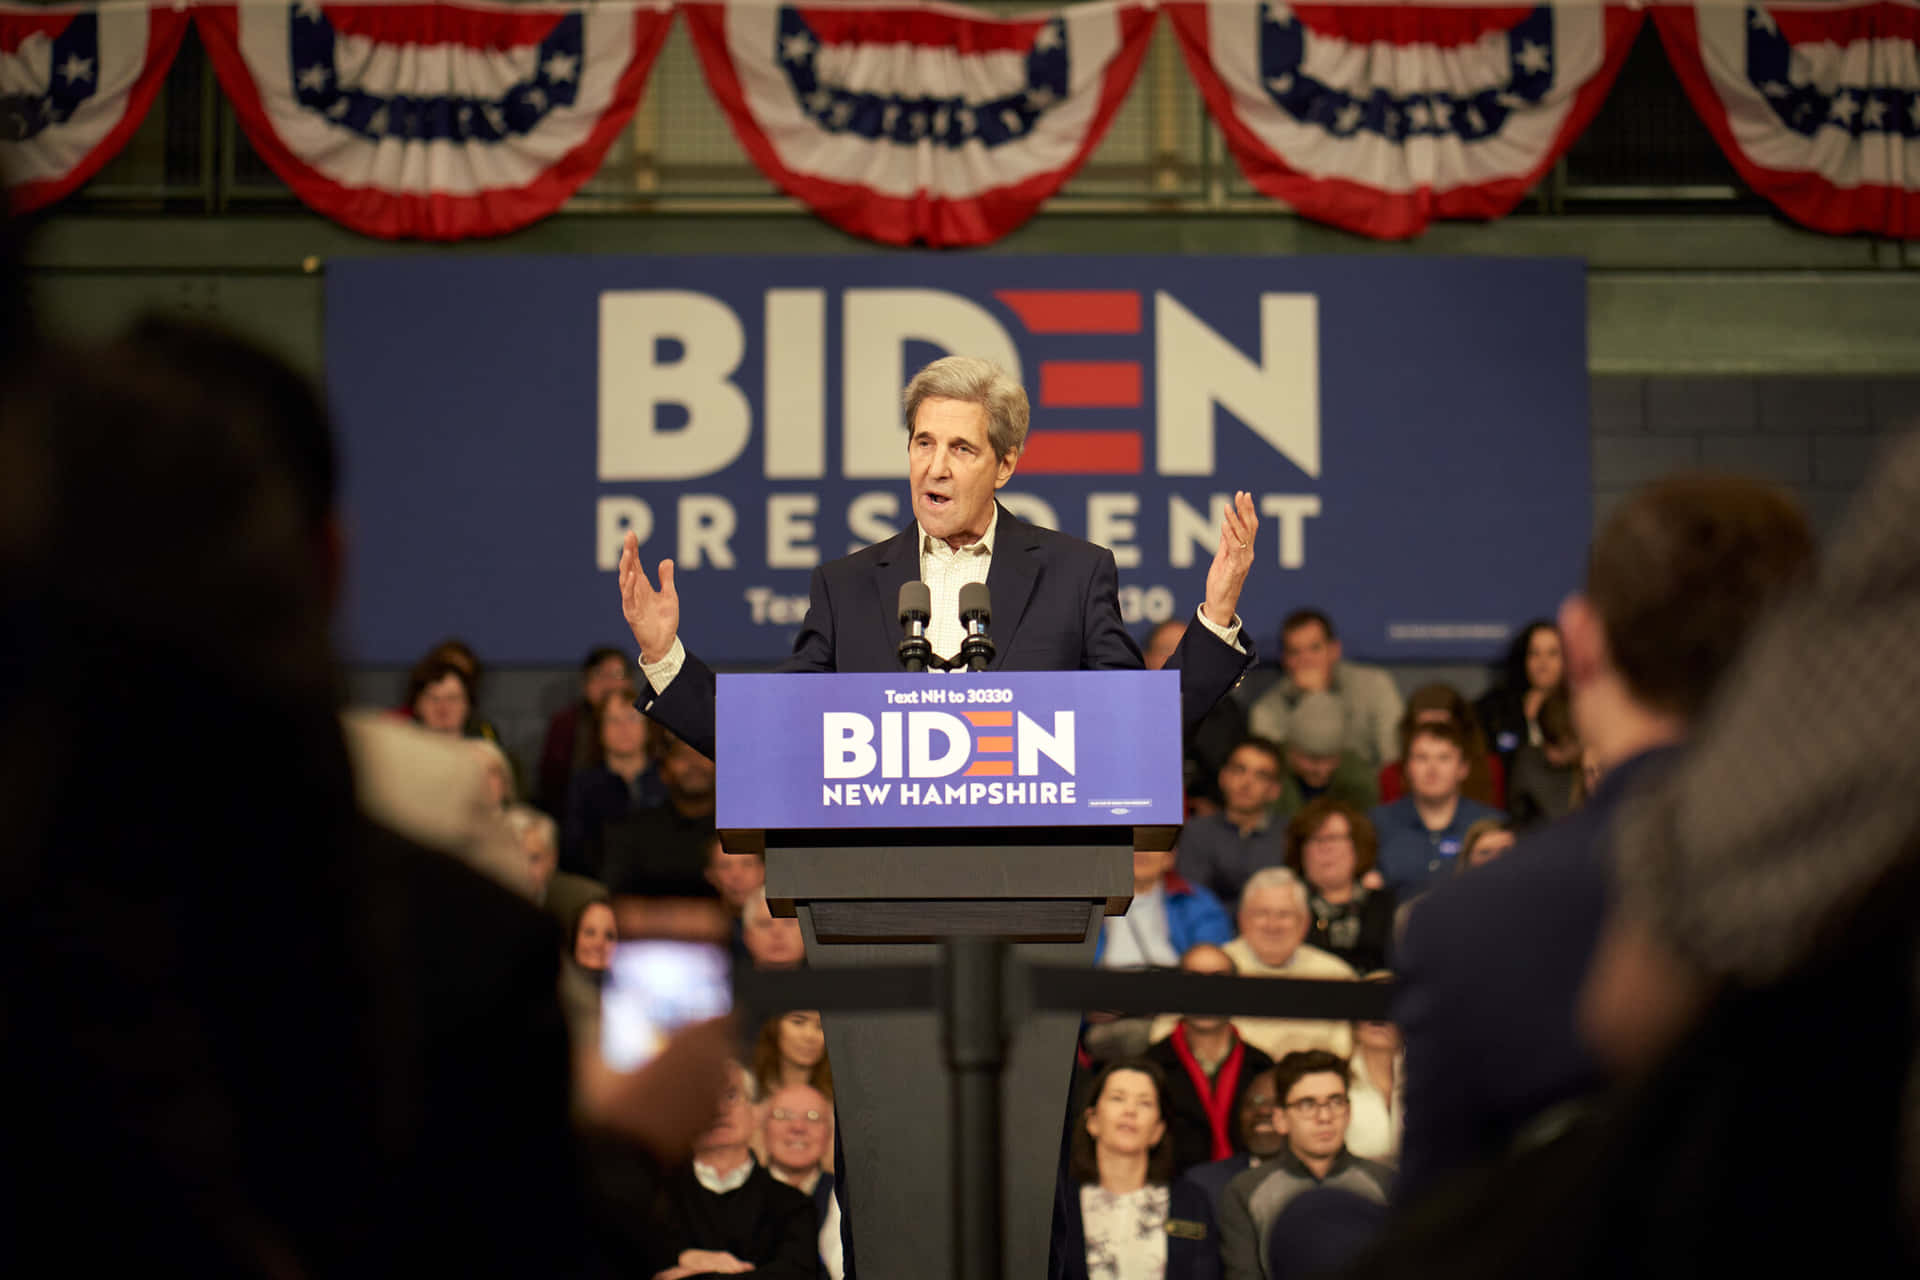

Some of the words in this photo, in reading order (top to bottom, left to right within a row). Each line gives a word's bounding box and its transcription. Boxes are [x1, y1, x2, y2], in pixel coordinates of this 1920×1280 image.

[597, 289, 1321, 480] BIDEN
[596, 493, 1321, 571] PRESENT
[884, 689, 919, 704] Text
[921, 689, 946, 704] NH
[948, 690, 965, 704] to
[967, 688, 1013, 704] 30330
[823, 710, 1076, 779] BIDEN
[823, 783, 891, 806] NEW
[901, 782, 1077, 806] HAMPSHIRE
